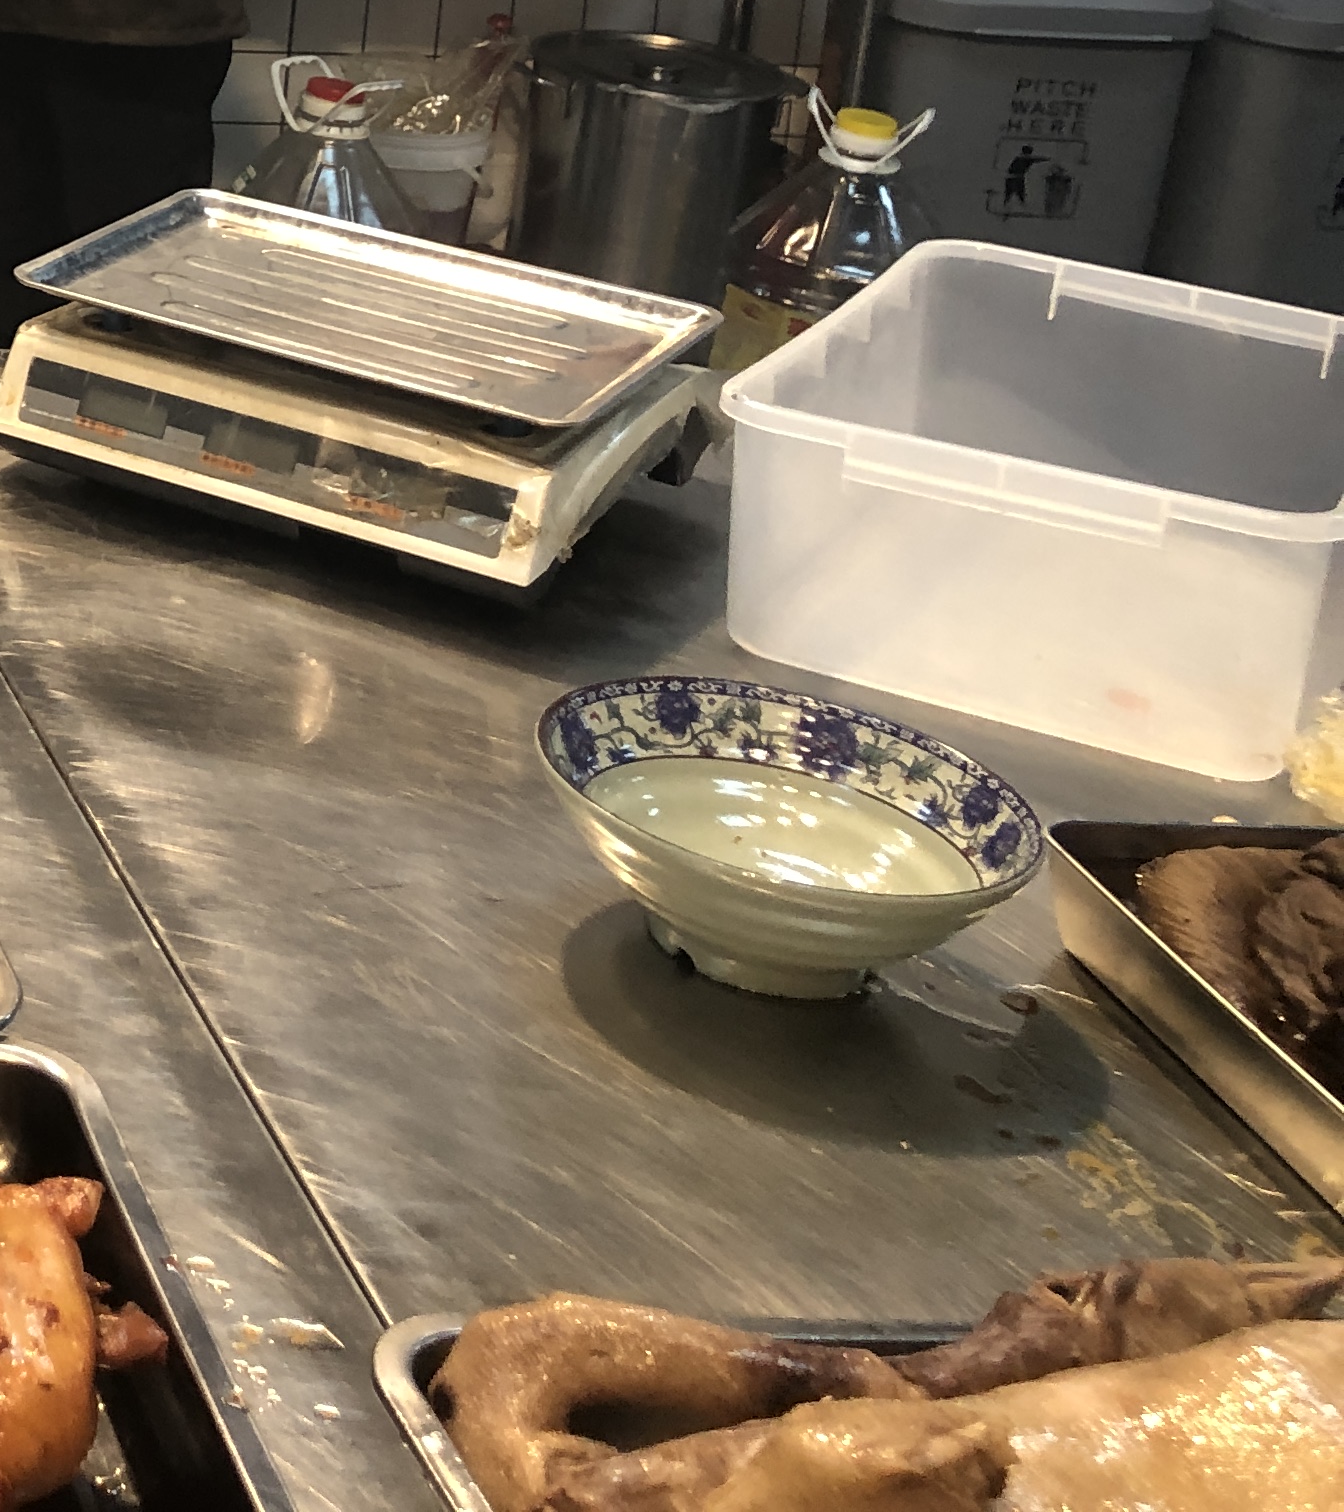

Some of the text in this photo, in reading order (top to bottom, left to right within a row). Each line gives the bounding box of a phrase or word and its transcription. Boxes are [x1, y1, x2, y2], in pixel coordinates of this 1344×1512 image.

[1015, 77, 1098, 97] PITCH
[1010, 98, 1092, 118] WASTE
[1007, 119, 1087, 138] HERE
